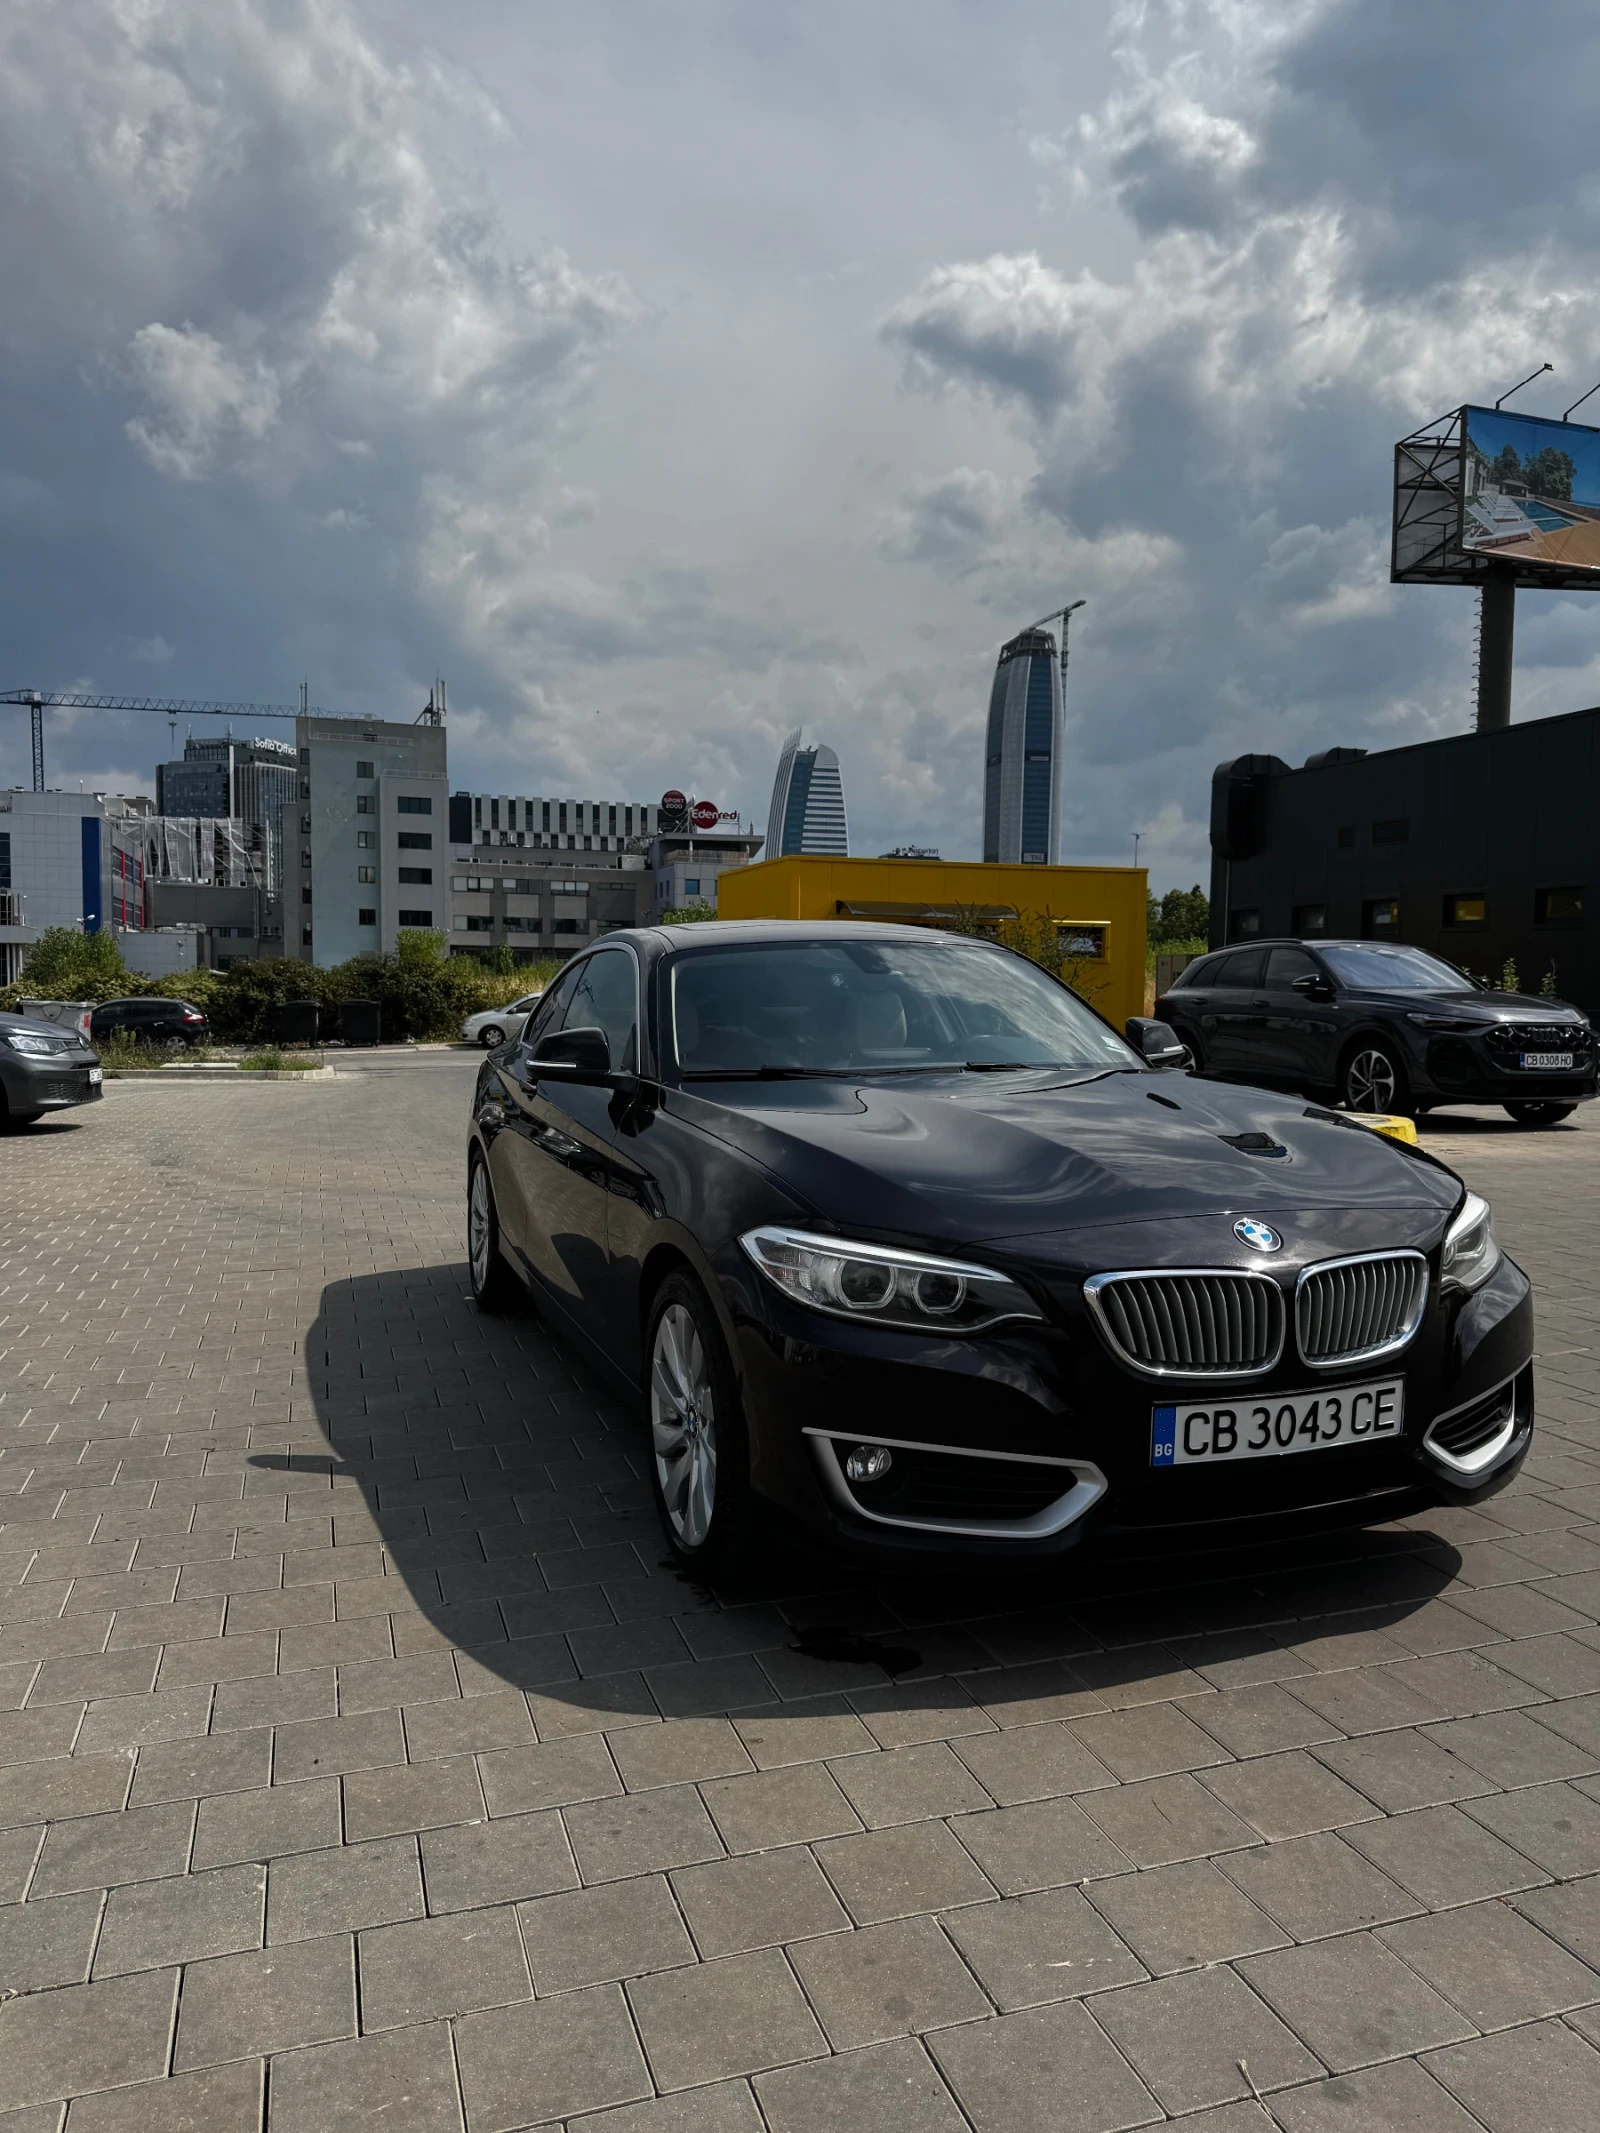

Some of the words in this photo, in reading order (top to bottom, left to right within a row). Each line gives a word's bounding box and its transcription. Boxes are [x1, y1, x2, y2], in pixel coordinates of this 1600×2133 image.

[255, 736, 275, 750] Sofia
[691, 808, 737, 820] Edenred
[1526, 1054, 1538, 1066] CB
[1560, 1055, 1571, 1066] HO
[1183, 1409, 1238, 1456] CB
[1248, 1397, 1342, 1450] 3043
[1350, 1387, 1397, 1435] CE
[1154, 1443, 1173, 1458] BG
